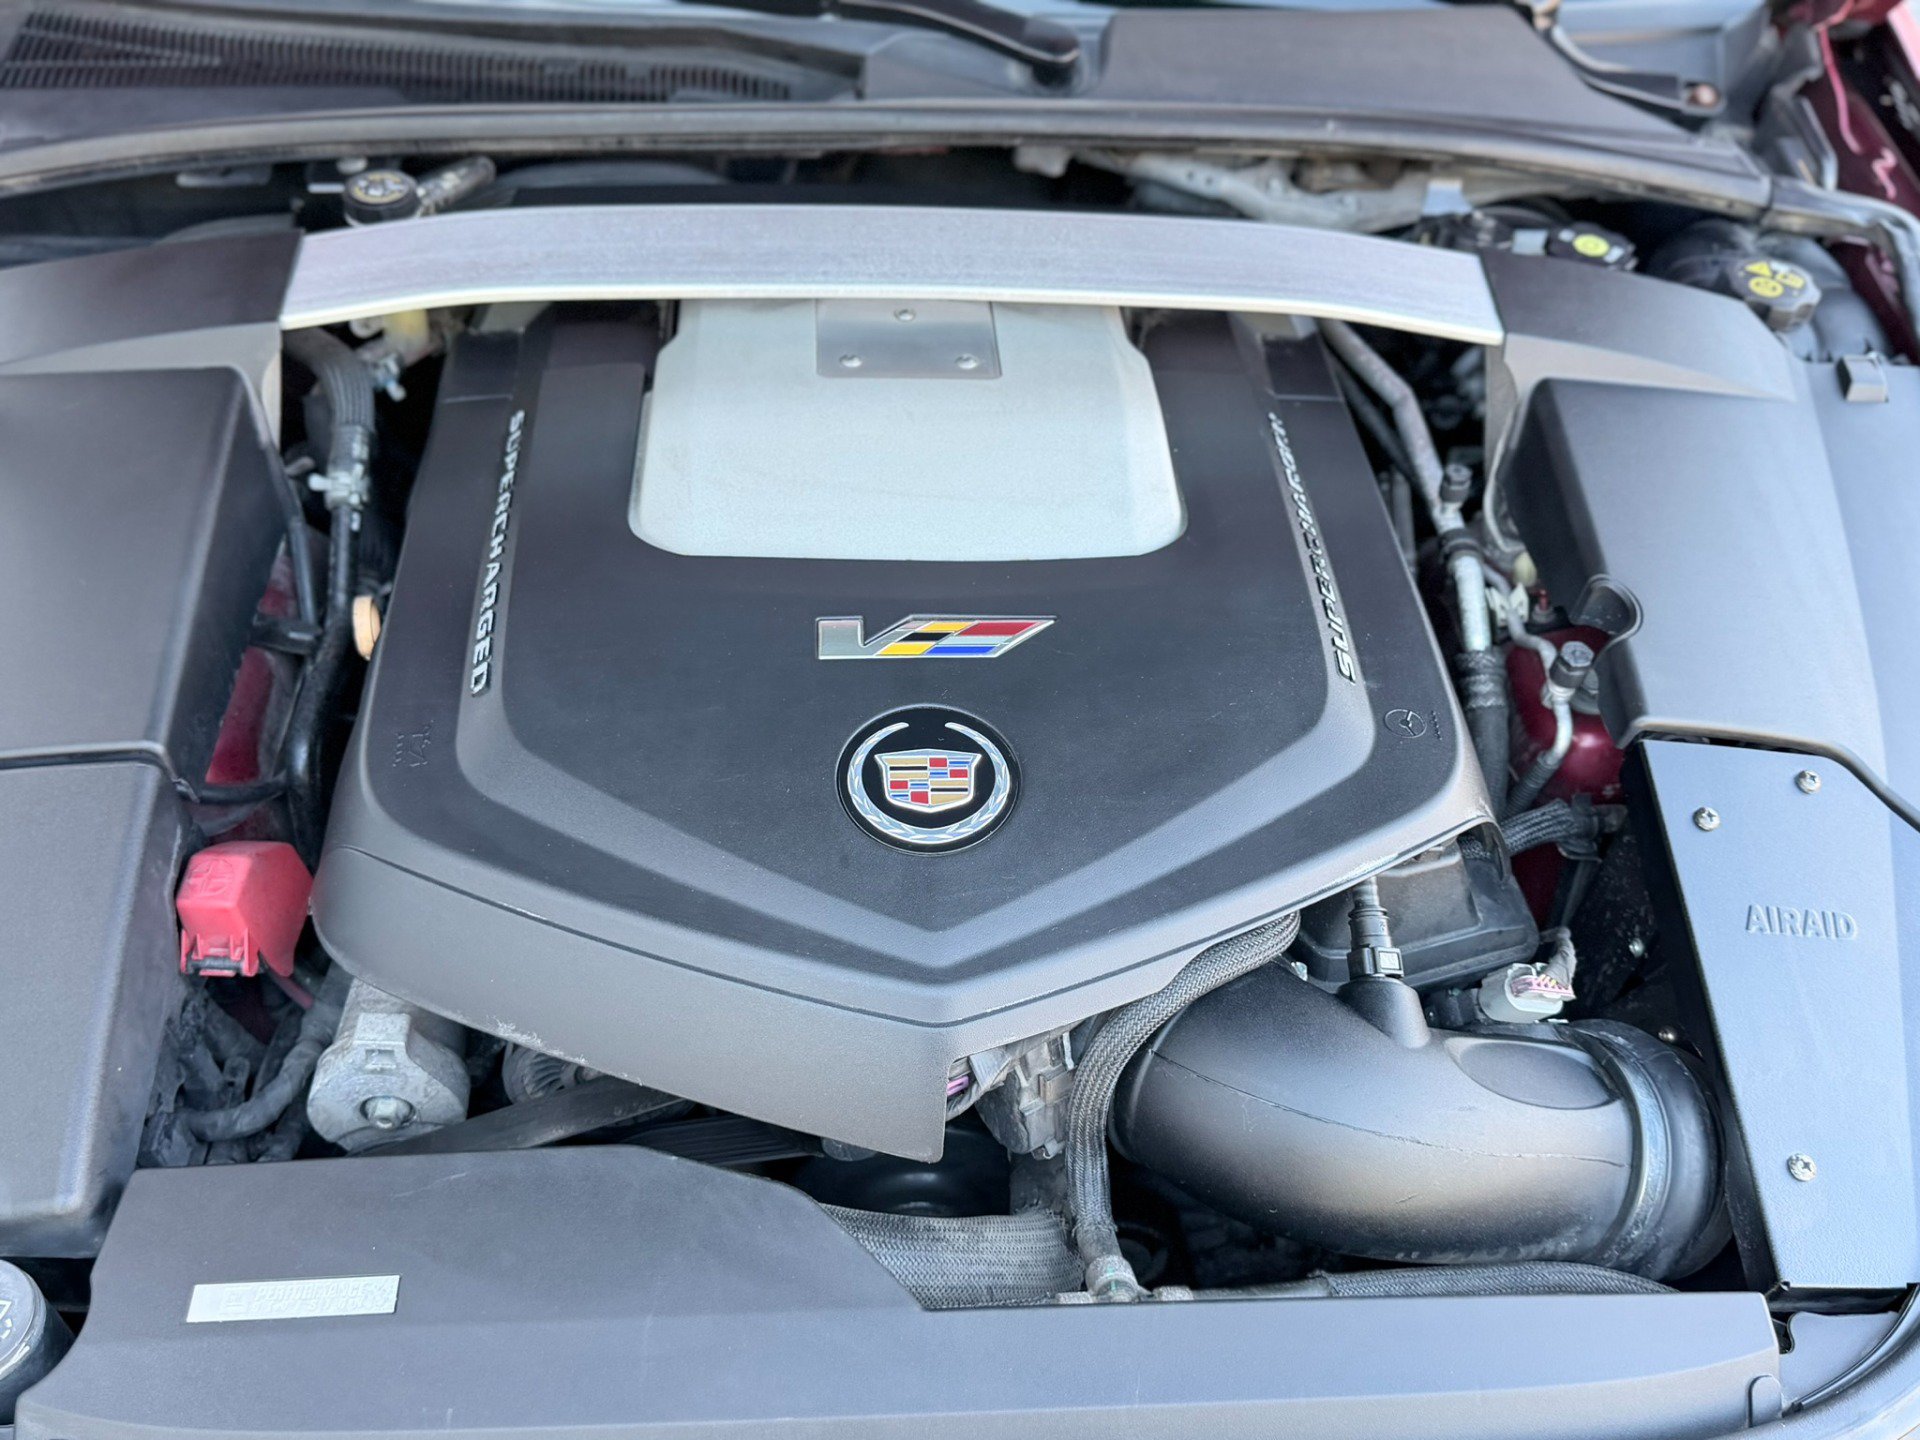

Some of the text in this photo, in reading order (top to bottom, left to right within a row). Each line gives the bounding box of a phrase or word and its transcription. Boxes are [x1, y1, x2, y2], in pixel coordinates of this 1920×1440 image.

[469, 409, 526, 697] SUPERCHARGED
[1267, 411, 1357, 685] SUPERCHARGED
[1745, 903, 1858, 941] AIRAID
